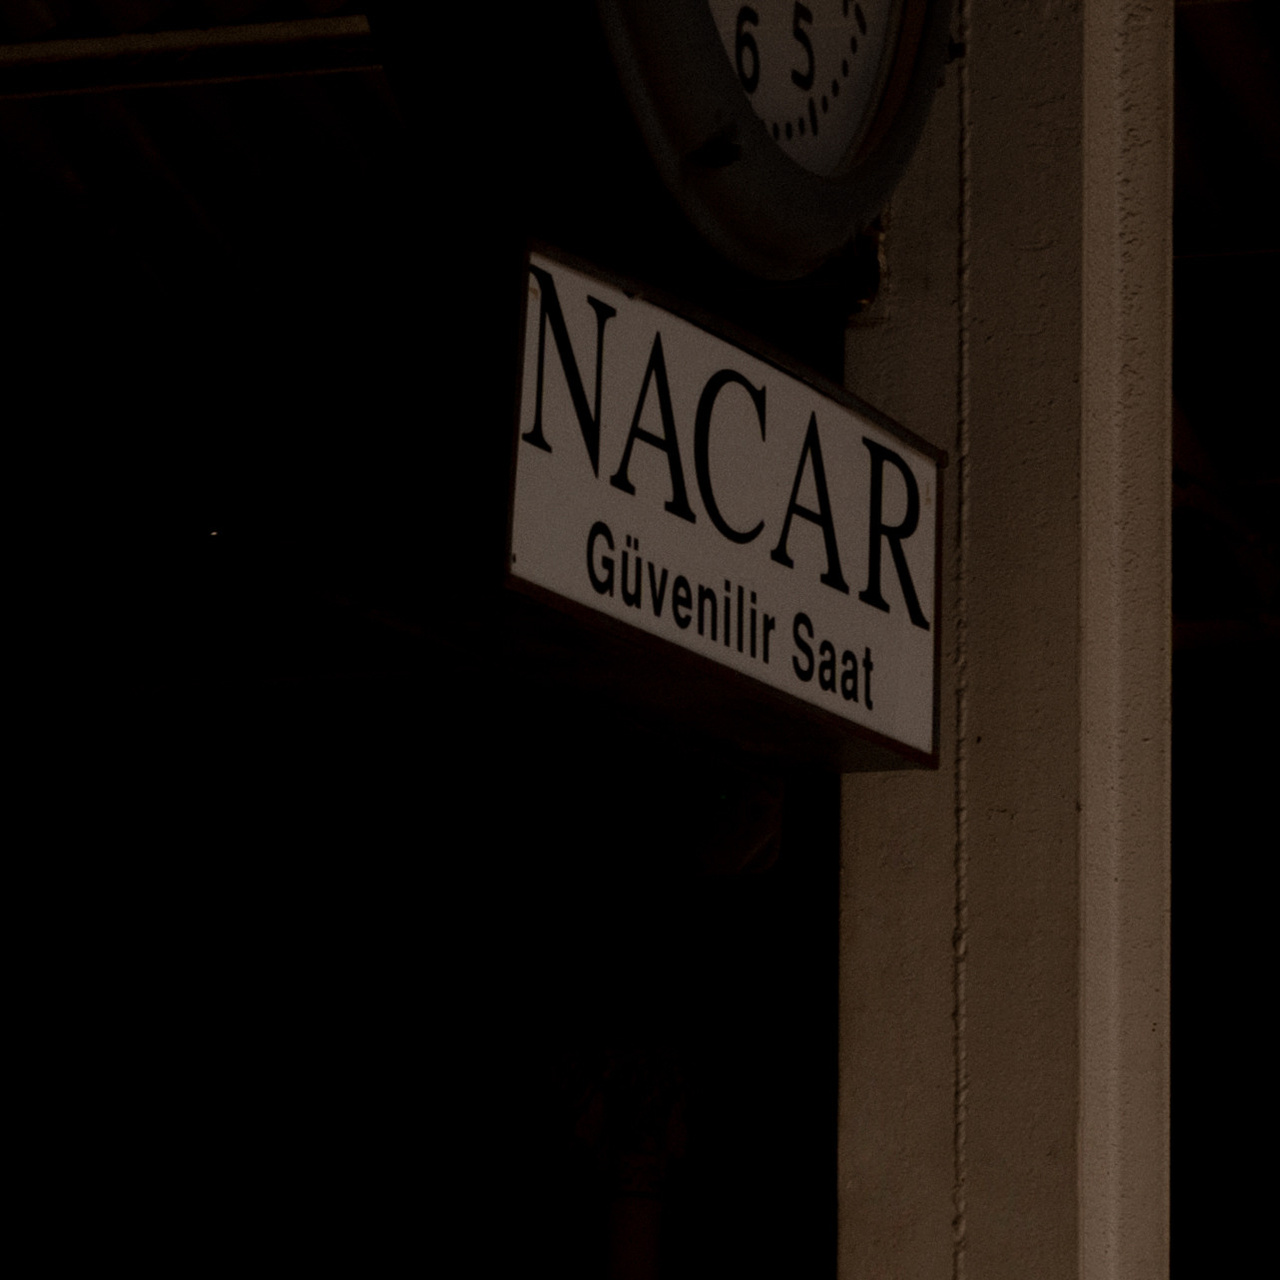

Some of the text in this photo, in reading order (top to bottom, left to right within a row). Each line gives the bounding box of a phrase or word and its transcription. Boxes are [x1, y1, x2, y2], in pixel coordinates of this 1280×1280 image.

[736, 6, 759, 93] 6
[791, 2, 814, 90] 5
[522, 264, 930, 632] NACAR
[586, 520, 874, 711] Güvenilir Saat
